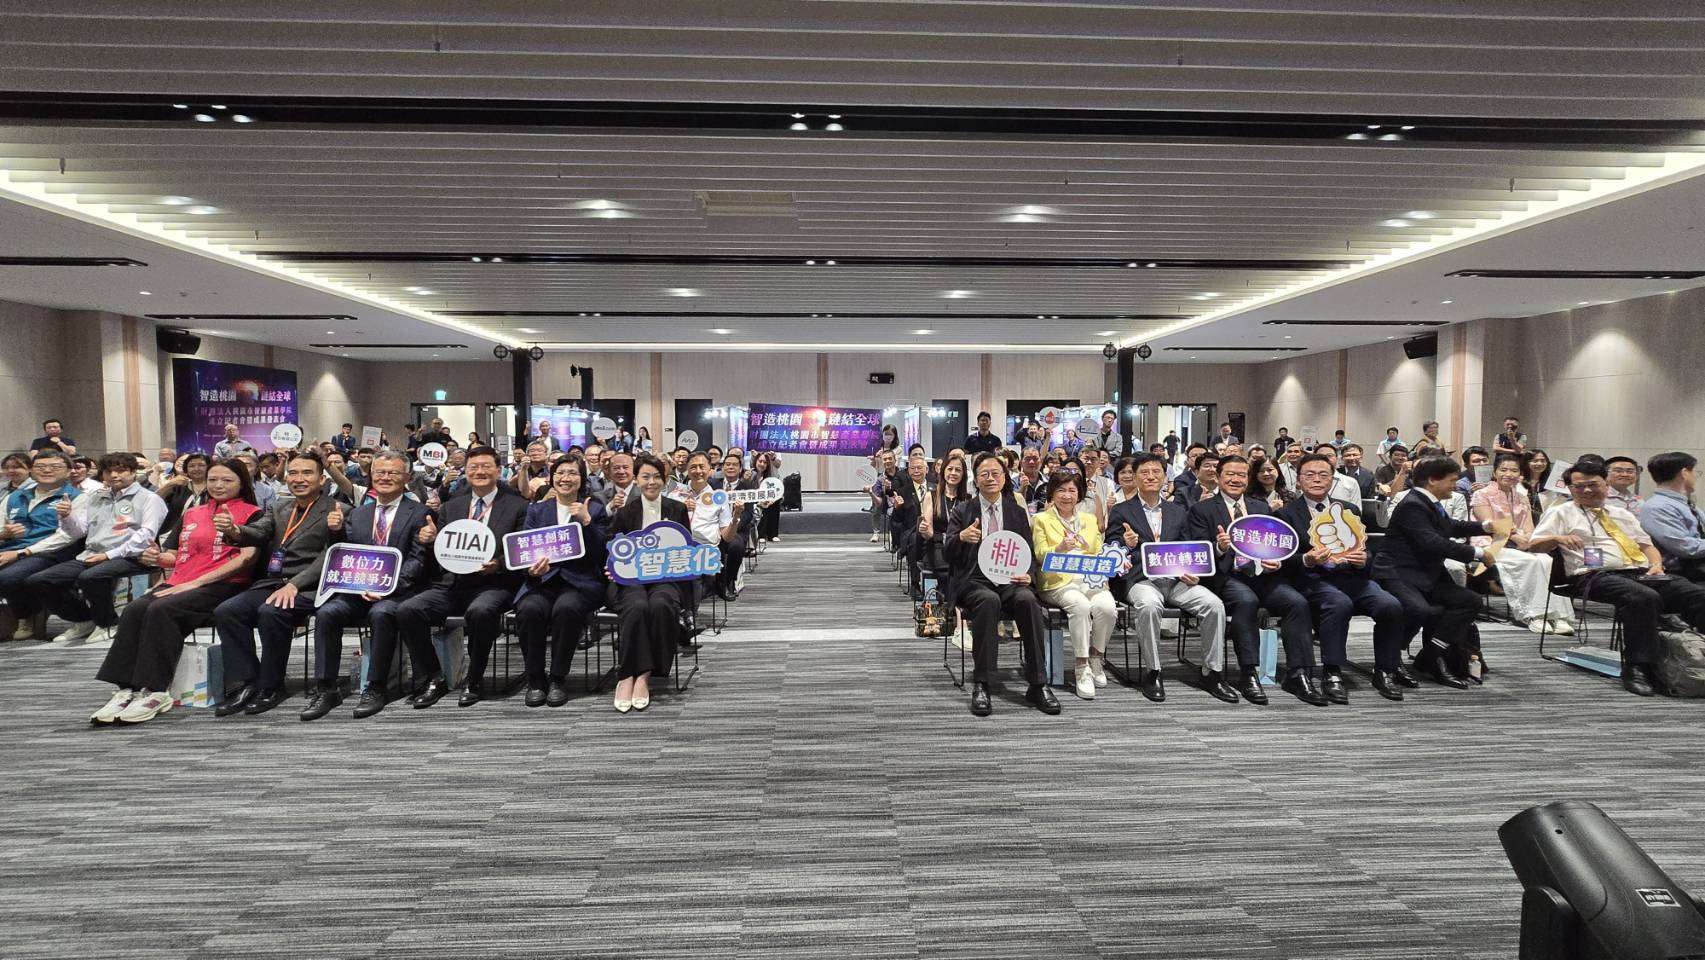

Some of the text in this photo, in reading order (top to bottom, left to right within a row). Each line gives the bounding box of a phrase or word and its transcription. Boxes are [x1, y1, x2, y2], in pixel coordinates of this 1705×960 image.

[751, 412, 880, 426] 智造桃園 鏈結全球
[728, 490, 775, 501] 經濟發展局
[444, 530, 488, 552] TIIAI
[517, 528, 570, 549] 智慧創新
[1232, 526, 1294, 549] 智造桃園
[341, 554, 384, 571] 數位力
[639, 547, 718, 577] 智慧化
[1049, 555, 1112, 574] 智慧製造
[1148, 550, 1209, 567] 數位轉型
[326, 569, 393, 587] 就是競爭力
